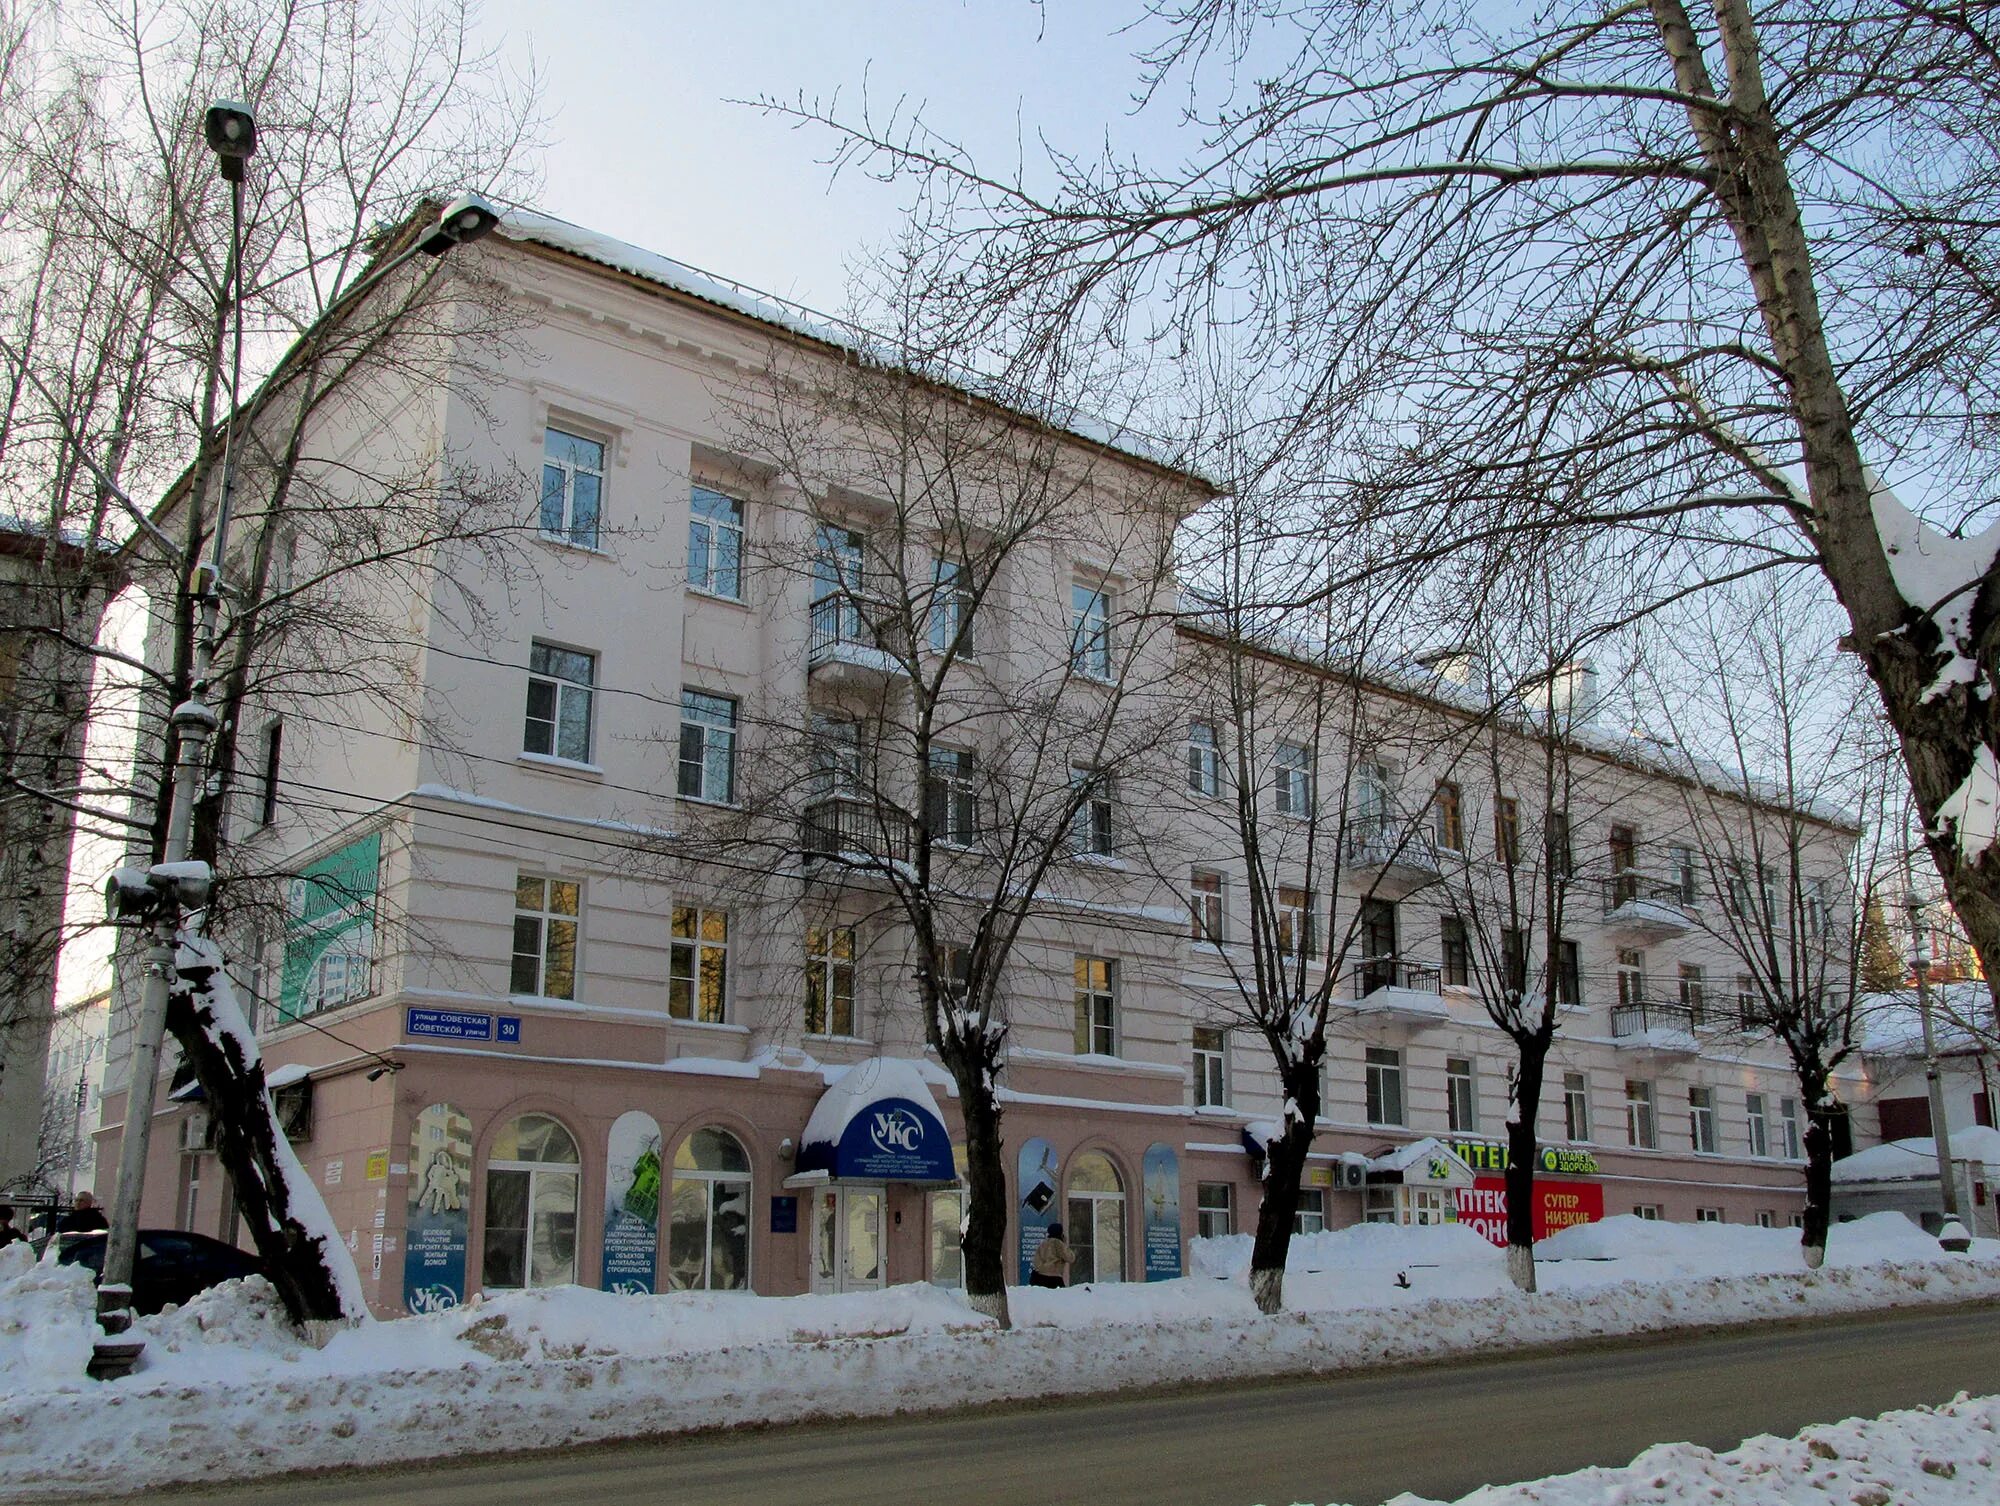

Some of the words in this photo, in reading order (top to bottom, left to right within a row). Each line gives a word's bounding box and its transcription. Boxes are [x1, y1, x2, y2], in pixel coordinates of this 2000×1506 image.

[415, 1013, 437, 1021] улица
[441, 1014, 487, 1025] СОВЕТСКАЯ
[502, 1024, 515, 1035] 30
[874, 1113, 919, 1151] УКС
[1430, 1159, 1449, 1178] 24
[1560, 1161, 1599, 1172] ЗДОРОВЬЯ
[1544, 1193, 1580, 1208] СУПЕР
[1545, 1210, 1590, 1226] НИЗКИЕ
[415, 1287, 453, 1313] УКС
